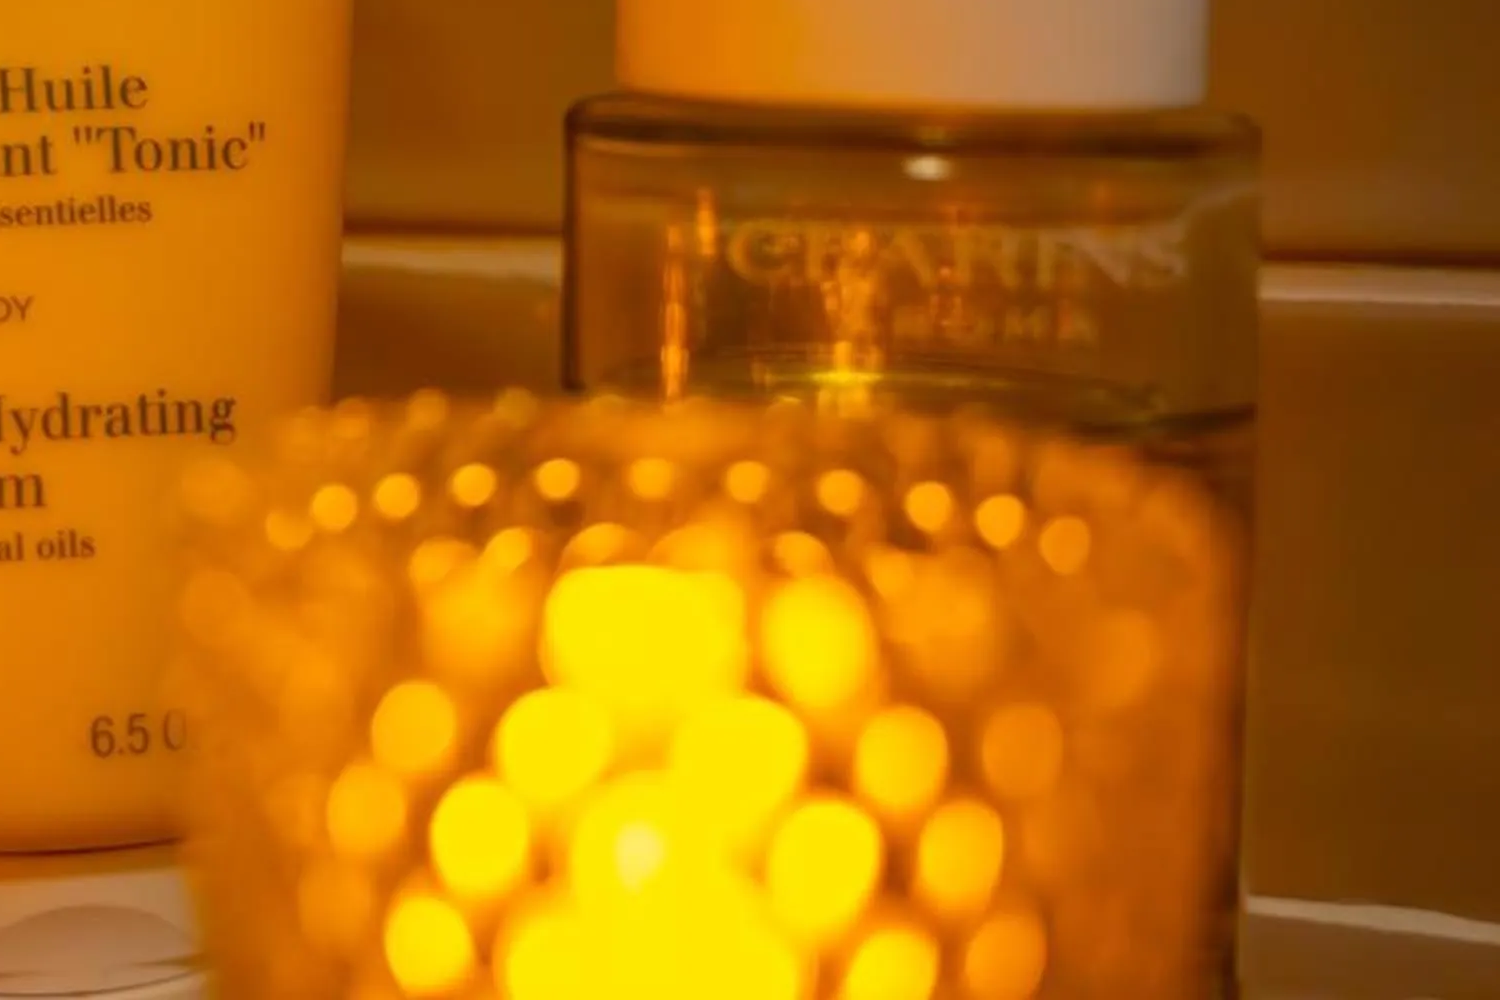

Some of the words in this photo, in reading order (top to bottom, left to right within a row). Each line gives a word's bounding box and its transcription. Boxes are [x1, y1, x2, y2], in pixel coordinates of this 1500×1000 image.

[73, 122, 267, 176] "Tonic"
[726, 216, 1190, 288] CLARINS
[37, 529, 96, 560] oils
[90, 713, 151, 760] 6.5
